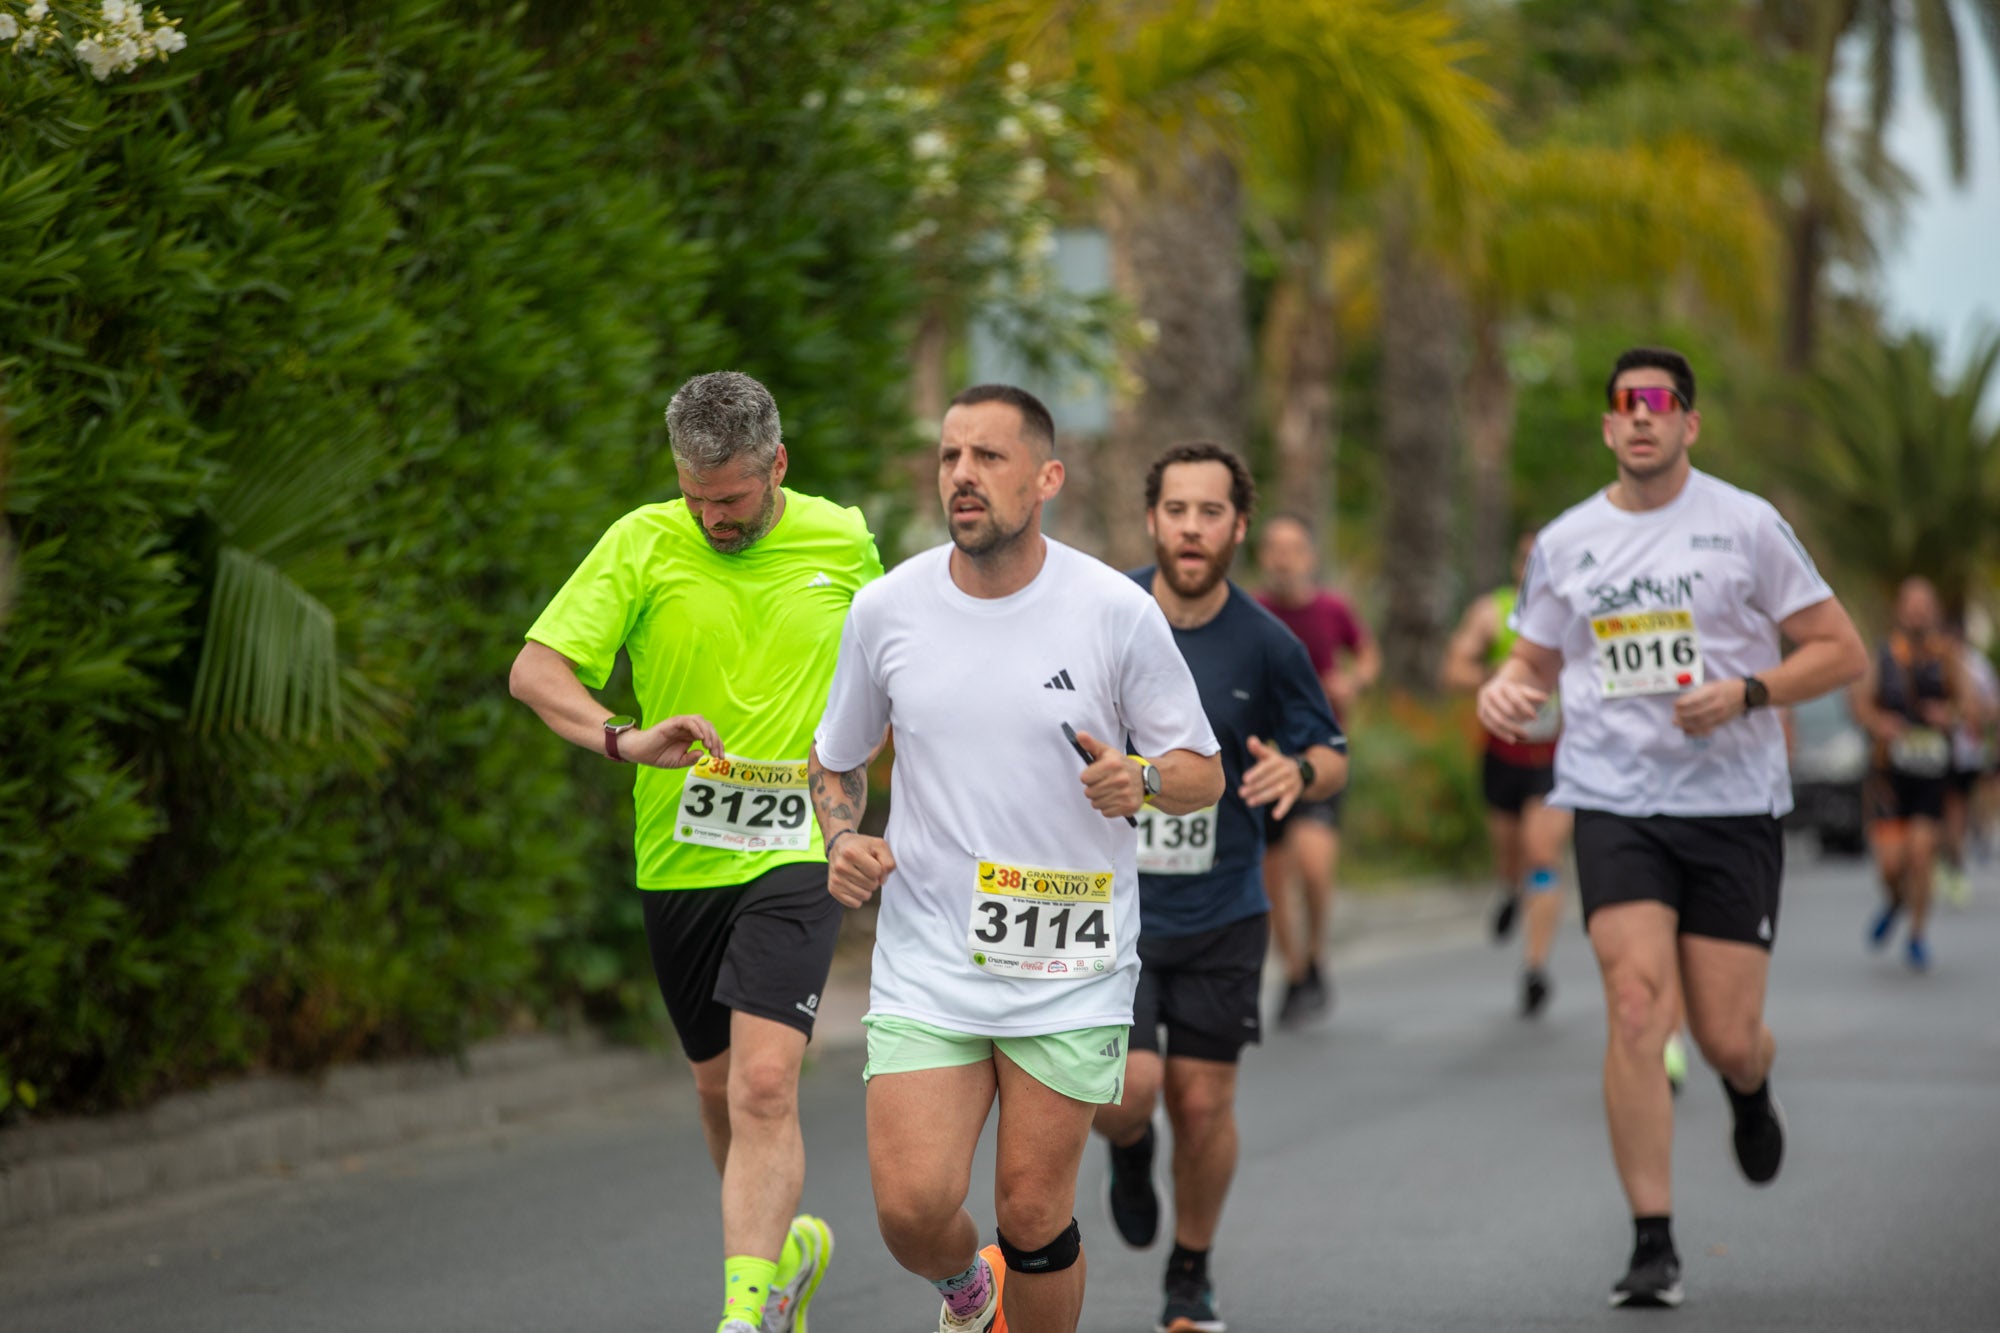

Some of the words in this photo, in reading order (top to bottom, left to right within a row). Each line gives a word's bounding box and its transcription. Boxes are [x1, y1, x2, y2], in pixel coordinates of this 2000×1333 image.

[1606, 636, 1695, 673] 1016
[709, 757, 731, 776] 38
[729, 767, 792, 784] FONDO
[735, 762, 759, 770] GRAN
[684, 784, 807, 829] 3129
[1140, 817, 1208, 848] 138
[997, 868, 1021, 889] 38
[1021, 877, 1089, 895] FONDO
[1026, 870, 1053, 879] GRAN
[1054, 873, 1086, 882] PREMIO
[974, 901, 1110, 949] 3114
